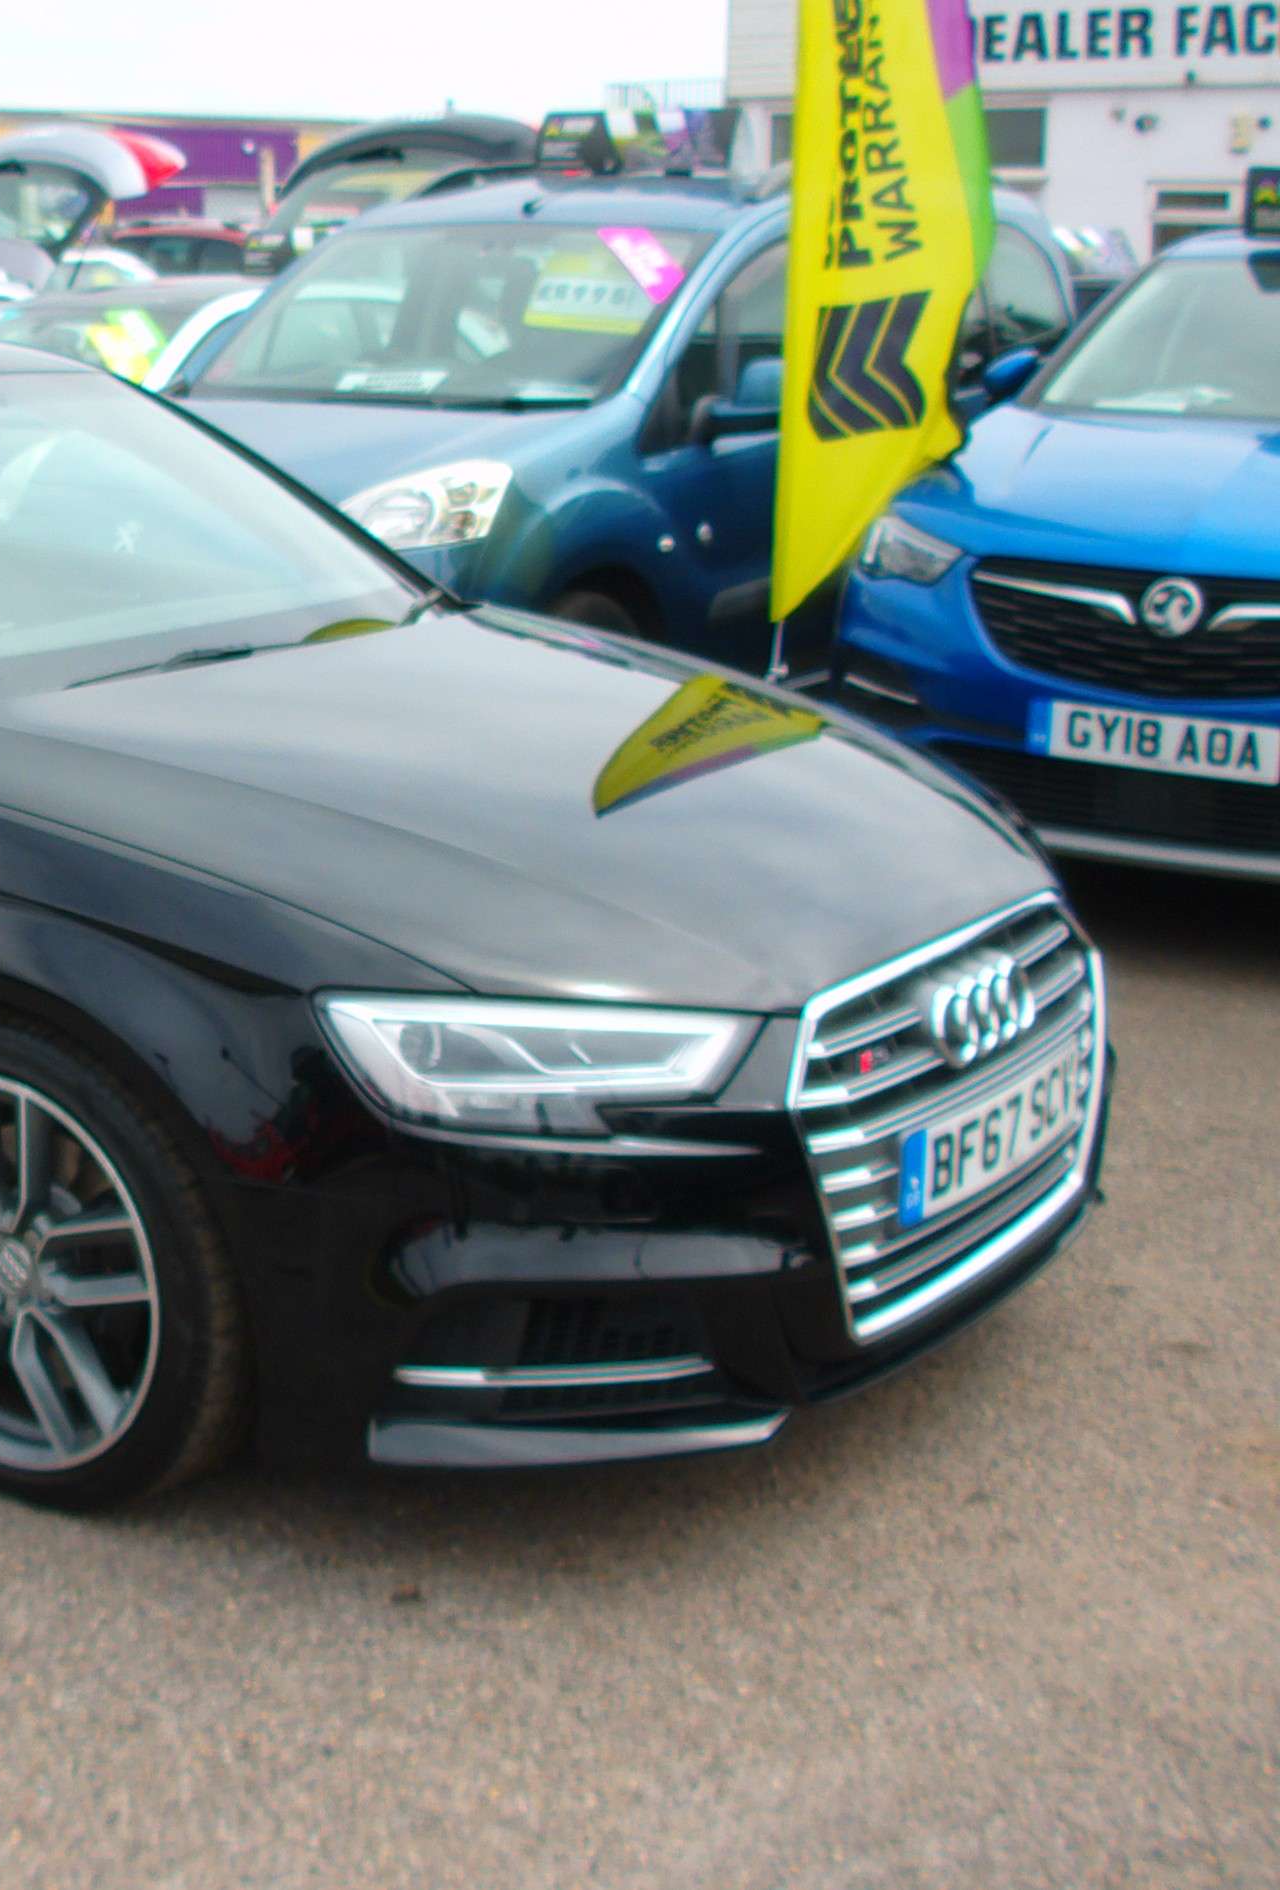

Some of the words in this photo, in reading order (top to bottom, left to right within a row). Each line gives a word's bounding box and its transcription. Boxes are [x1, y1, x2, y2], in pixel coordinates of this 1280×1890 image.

[971, 8, 1153, 62] EALER
[1068, 710, 1162, 758] GY18
[1176, 724, 1260, 771] AOA
[931, 1094, 1022, 1199] BF67
